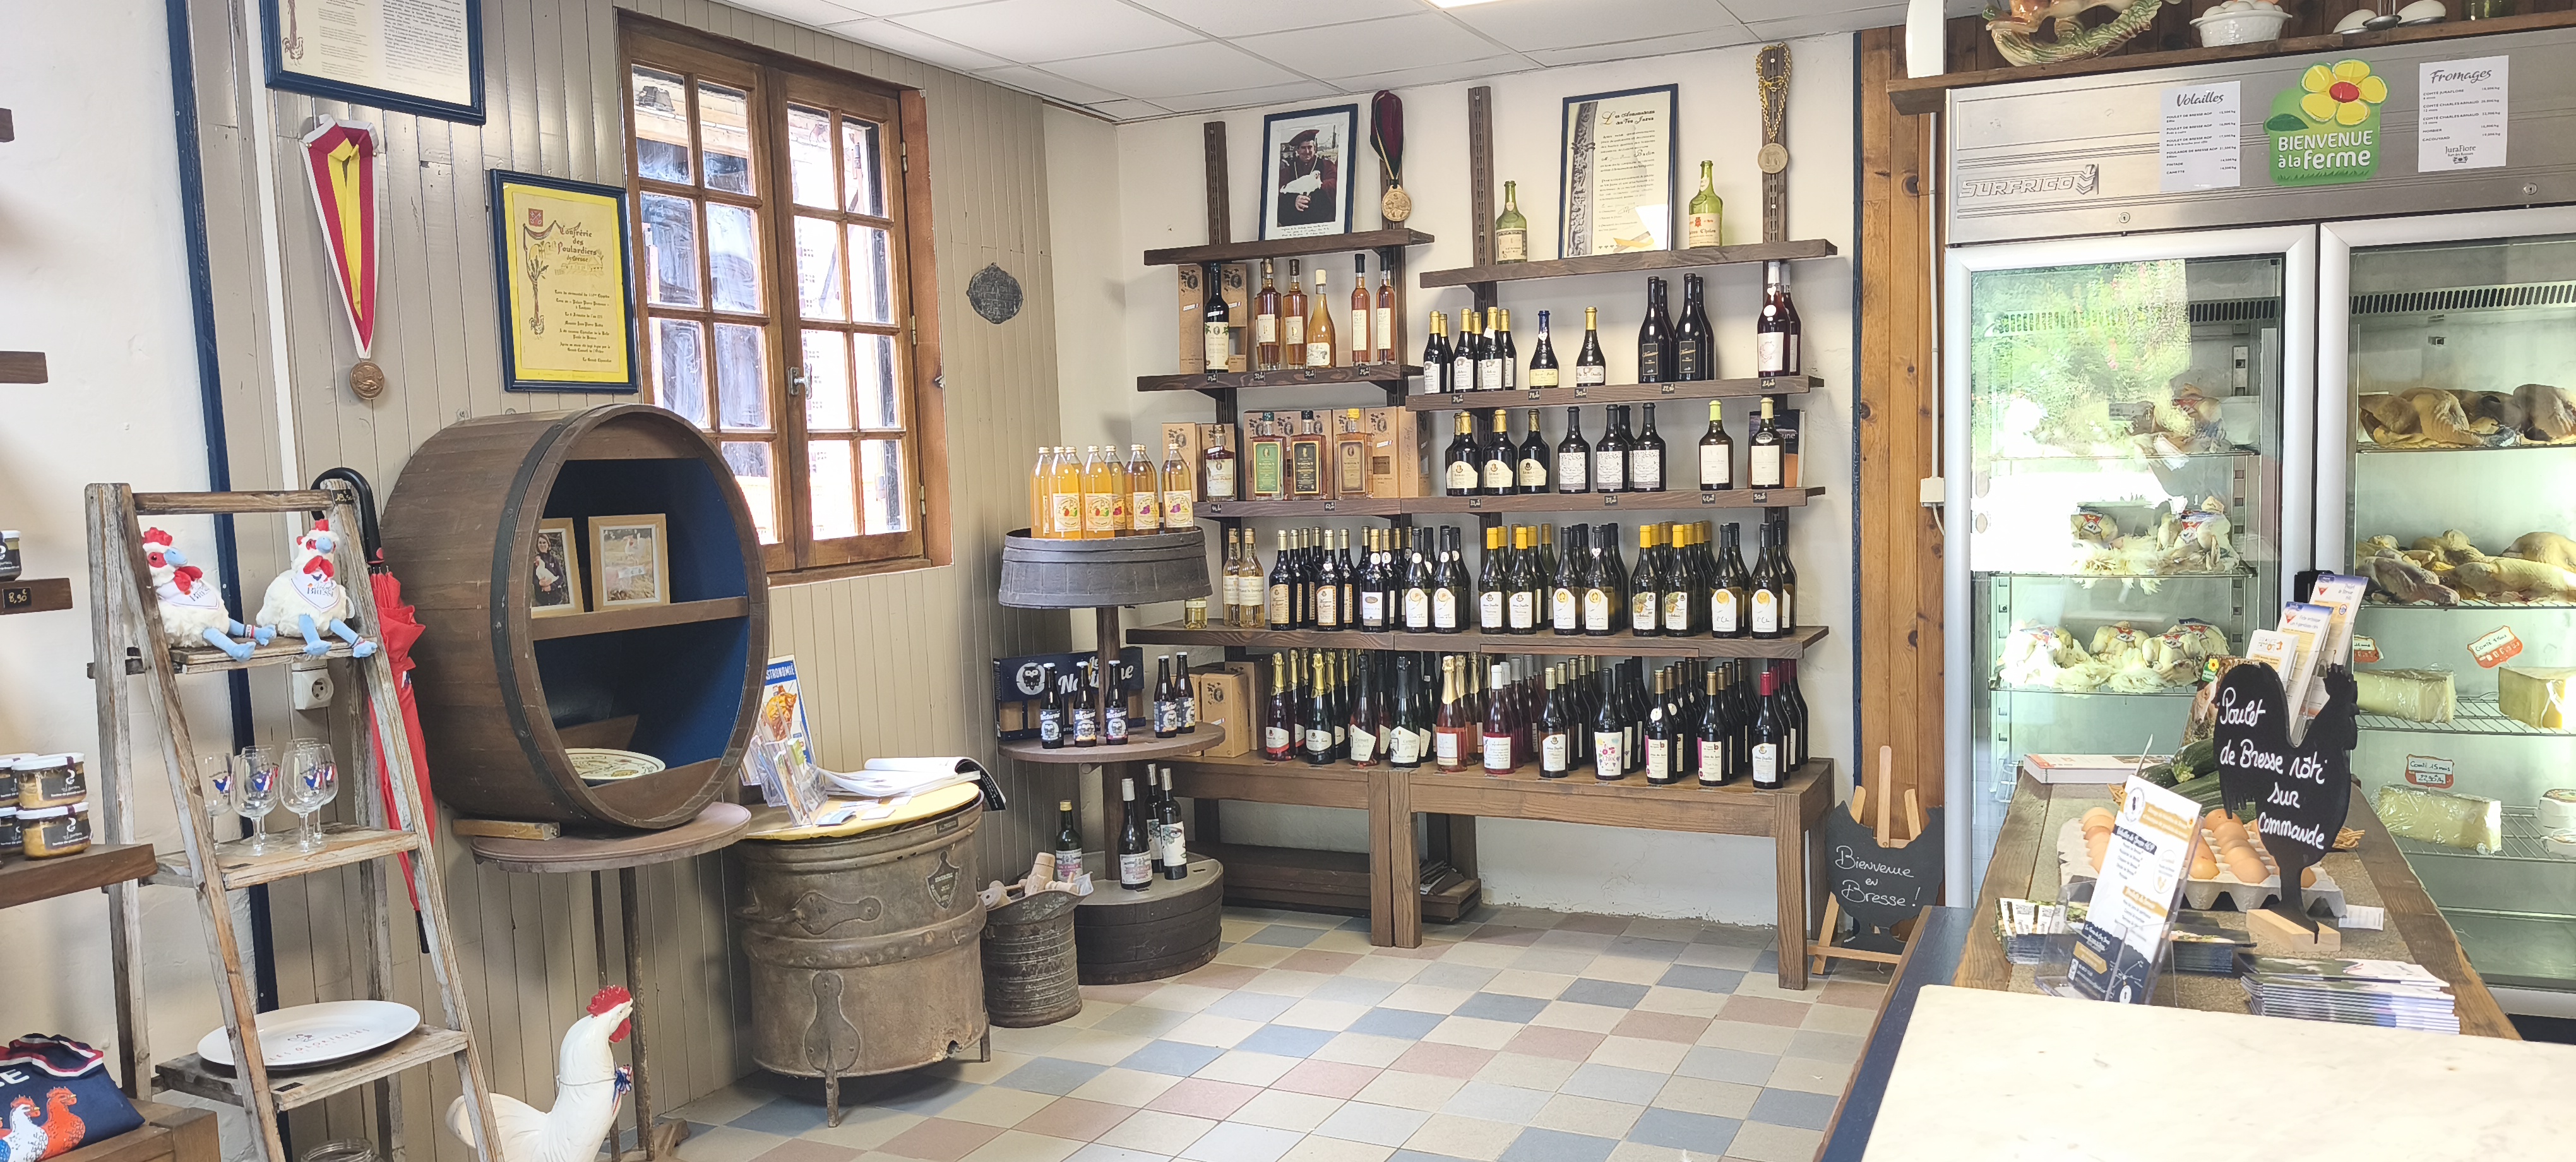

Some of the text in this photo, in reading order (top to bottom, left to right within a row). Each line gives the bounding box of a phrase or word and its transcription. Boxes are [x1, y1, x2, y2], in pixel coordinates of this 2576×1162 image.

[2430, 69, 2492, 83] Fromages
[2177, 92, 2224, 107] Volailles
[2278, 130, 2373, 151] BIENVENUE
[2445, 145, 2476, 154] JuraFlore
[2278, 150, 2371, 170] à la ferme
[1959, 176, 2075, 198] SURFRIGO
[558, 241, 598, 255] Poulardiers
[573, 236, 584, 246] des
[766, 664, 794, 680] STRONOMIE
[2219, 686, 2266, 727] Poulet
[2220, 738, 2329, 784] de Bresse rôti
[2267, 782, 2301, 808] sur
[1835, 845, 1914, 878] Bienvenue
[1865, 877, 1878, 886] en
[1841, 879, 1921, 907] Bresse !
